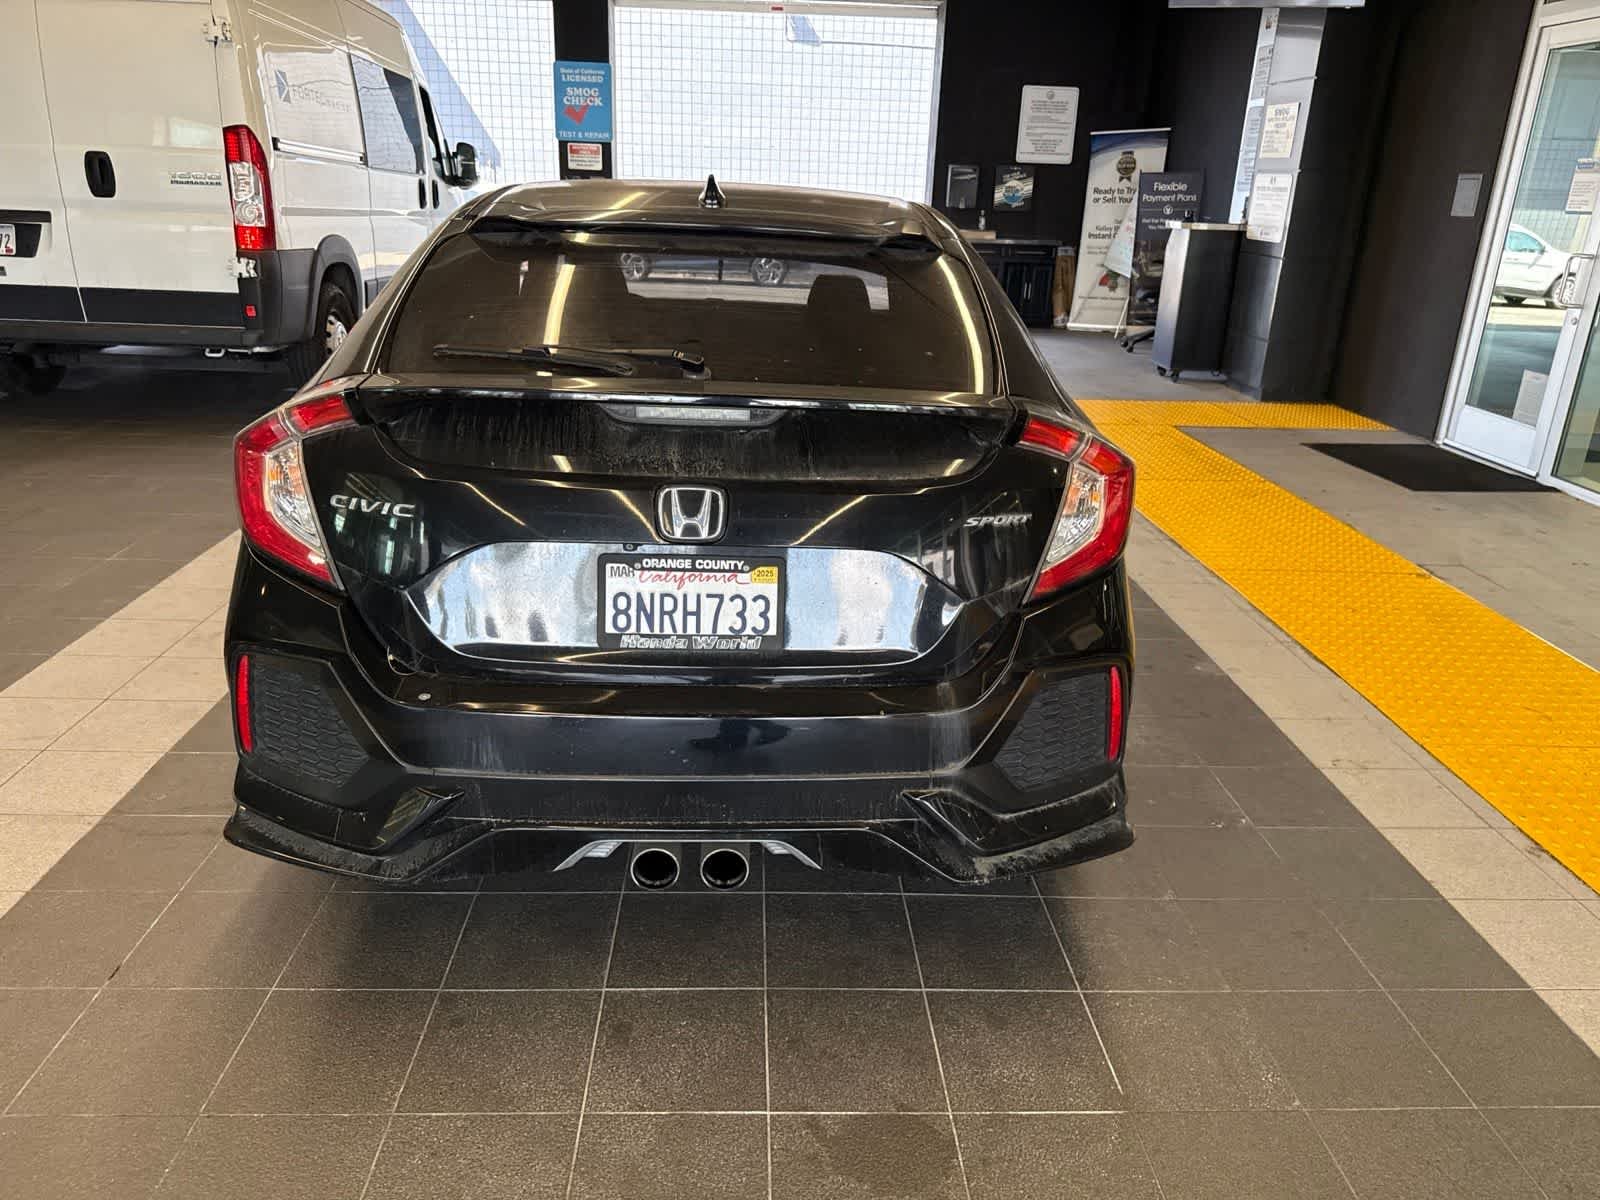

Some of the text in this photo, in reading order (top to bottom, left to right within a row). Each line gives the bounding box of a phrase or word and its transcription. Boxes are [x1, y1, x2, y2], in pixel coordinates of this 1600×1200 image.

[561, 73, 604, 83] LICENSED
[566, 87, 600, 97] SMOG
[563, 95, 604, 107] CHECK
[560, 130, 577, 138] TEST
[1093, 187, 1116, 197] Ready
[1117, 187, 1125, 195] to
[1153, 181, 1188, 192] Flexible
[1102, 196, 1116, 204] Sell
[1142, 193, 1197, 203] Payment Plans
[1088, 231, 1112, 240] Instant
[330, 494, 416, 518] CIVIC
[963, 513, 1033, 528] SPORT
[642, 558, 744, 570] ORANGE COUNTY
[610, 565, 635, 578] MAR
[638, 570, 751, 591] California
[612, 591, 771, 636] 8NRH733
[619, 634, 762, 650] Honda World
